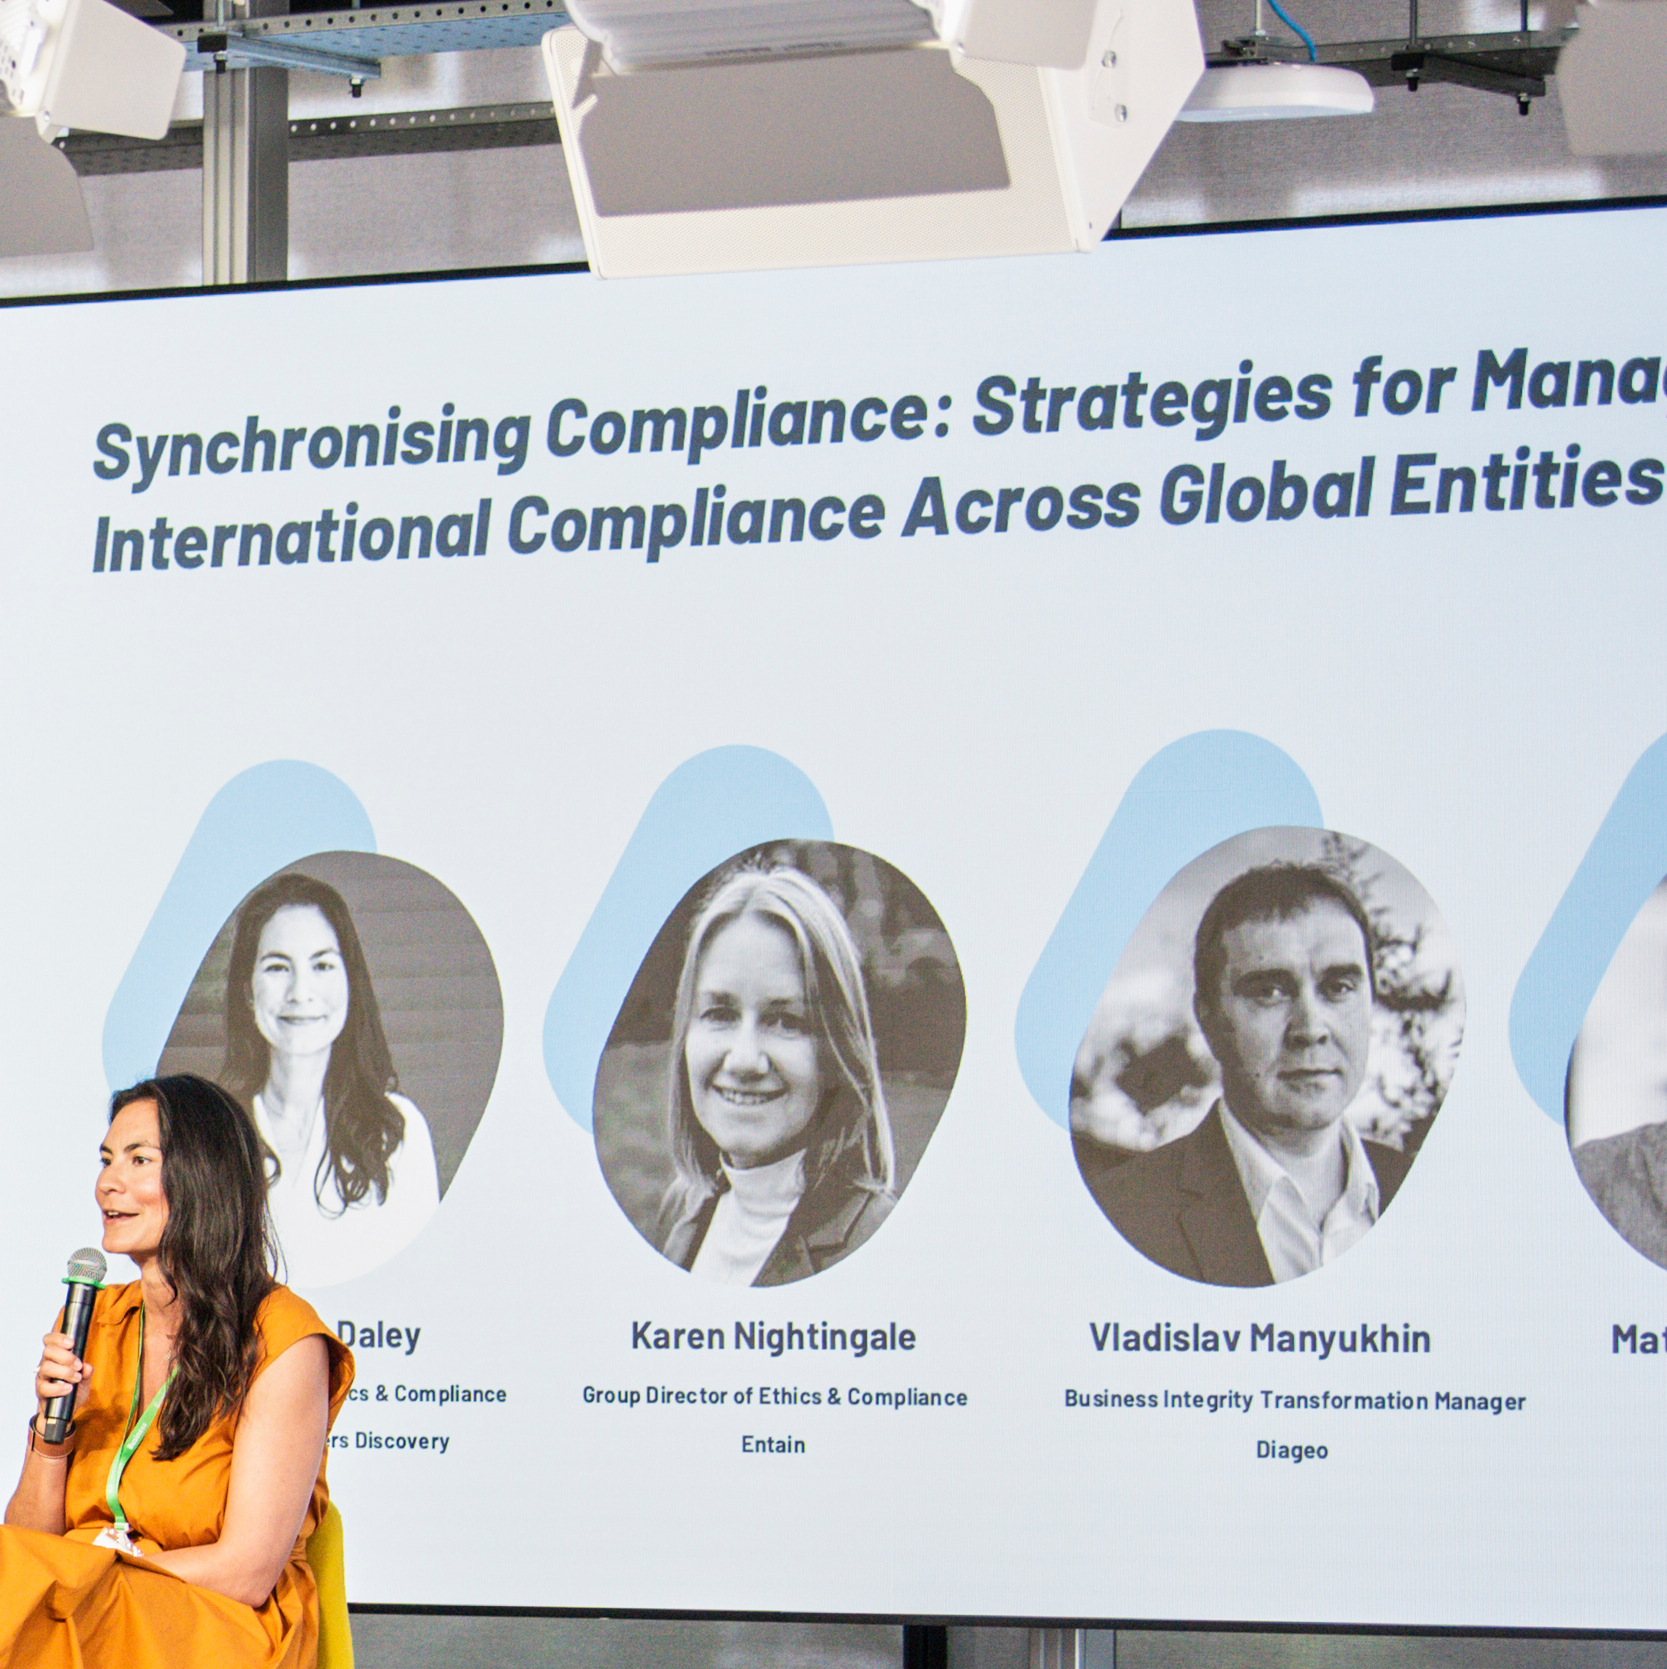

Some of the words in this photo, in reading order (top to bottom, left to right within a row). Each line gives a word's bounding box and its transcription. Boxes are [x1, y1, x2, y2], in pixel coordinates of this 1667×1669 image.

[94, 402, 531, 494] Synchronising
[547, 385, 952, 465] Compliance:
[973, 359, 1332, 441] Strategies
[1353, 355, 1457, 417] for
[1472, 347, 1667, 411] Mana
[93, 498, 492, 572] International
[509, 484, 885, 563] Compliance
[901, 476, 1141, 537] Across
[1161, 455, 1376, 525] Global
[1391, 443, 1665, 515] Entities
[336, 1319, 422, 1357] Daley
[632, 1320, 725, 1350] Karen
[734, 1320, 917, 1358] Nightingale
[1089, 1321, 1241, 1353] Vladislav
[1250, 1322, 1431, 1361] Manyukhin
[375, 1384, 389, 1402] &
[394, 1384, 507, 1407] Compliance
[583, 1385, 641, 1408] Group
[646, 1385, 729, 1405] Director
[733, 1386, 754, 1405] of
[759, 1386, 823, 1405] Ethics
[827, 1387, 842, 1406] &
[848, 1387, 968, 1411] Compliance
[1065, 1388, 1159, 1408] Business
[1164, 1389, 1254, 1414] Integrity
[1260, 1390, 1429, 1410] Transformation
[1435, 1391, 1527, 1416] Manager
[355, 1431, 450, 1455] Discovery
[742, 1434, 806, 1454] Entain
[1257, 1439, 1329, 1464] Diageo
